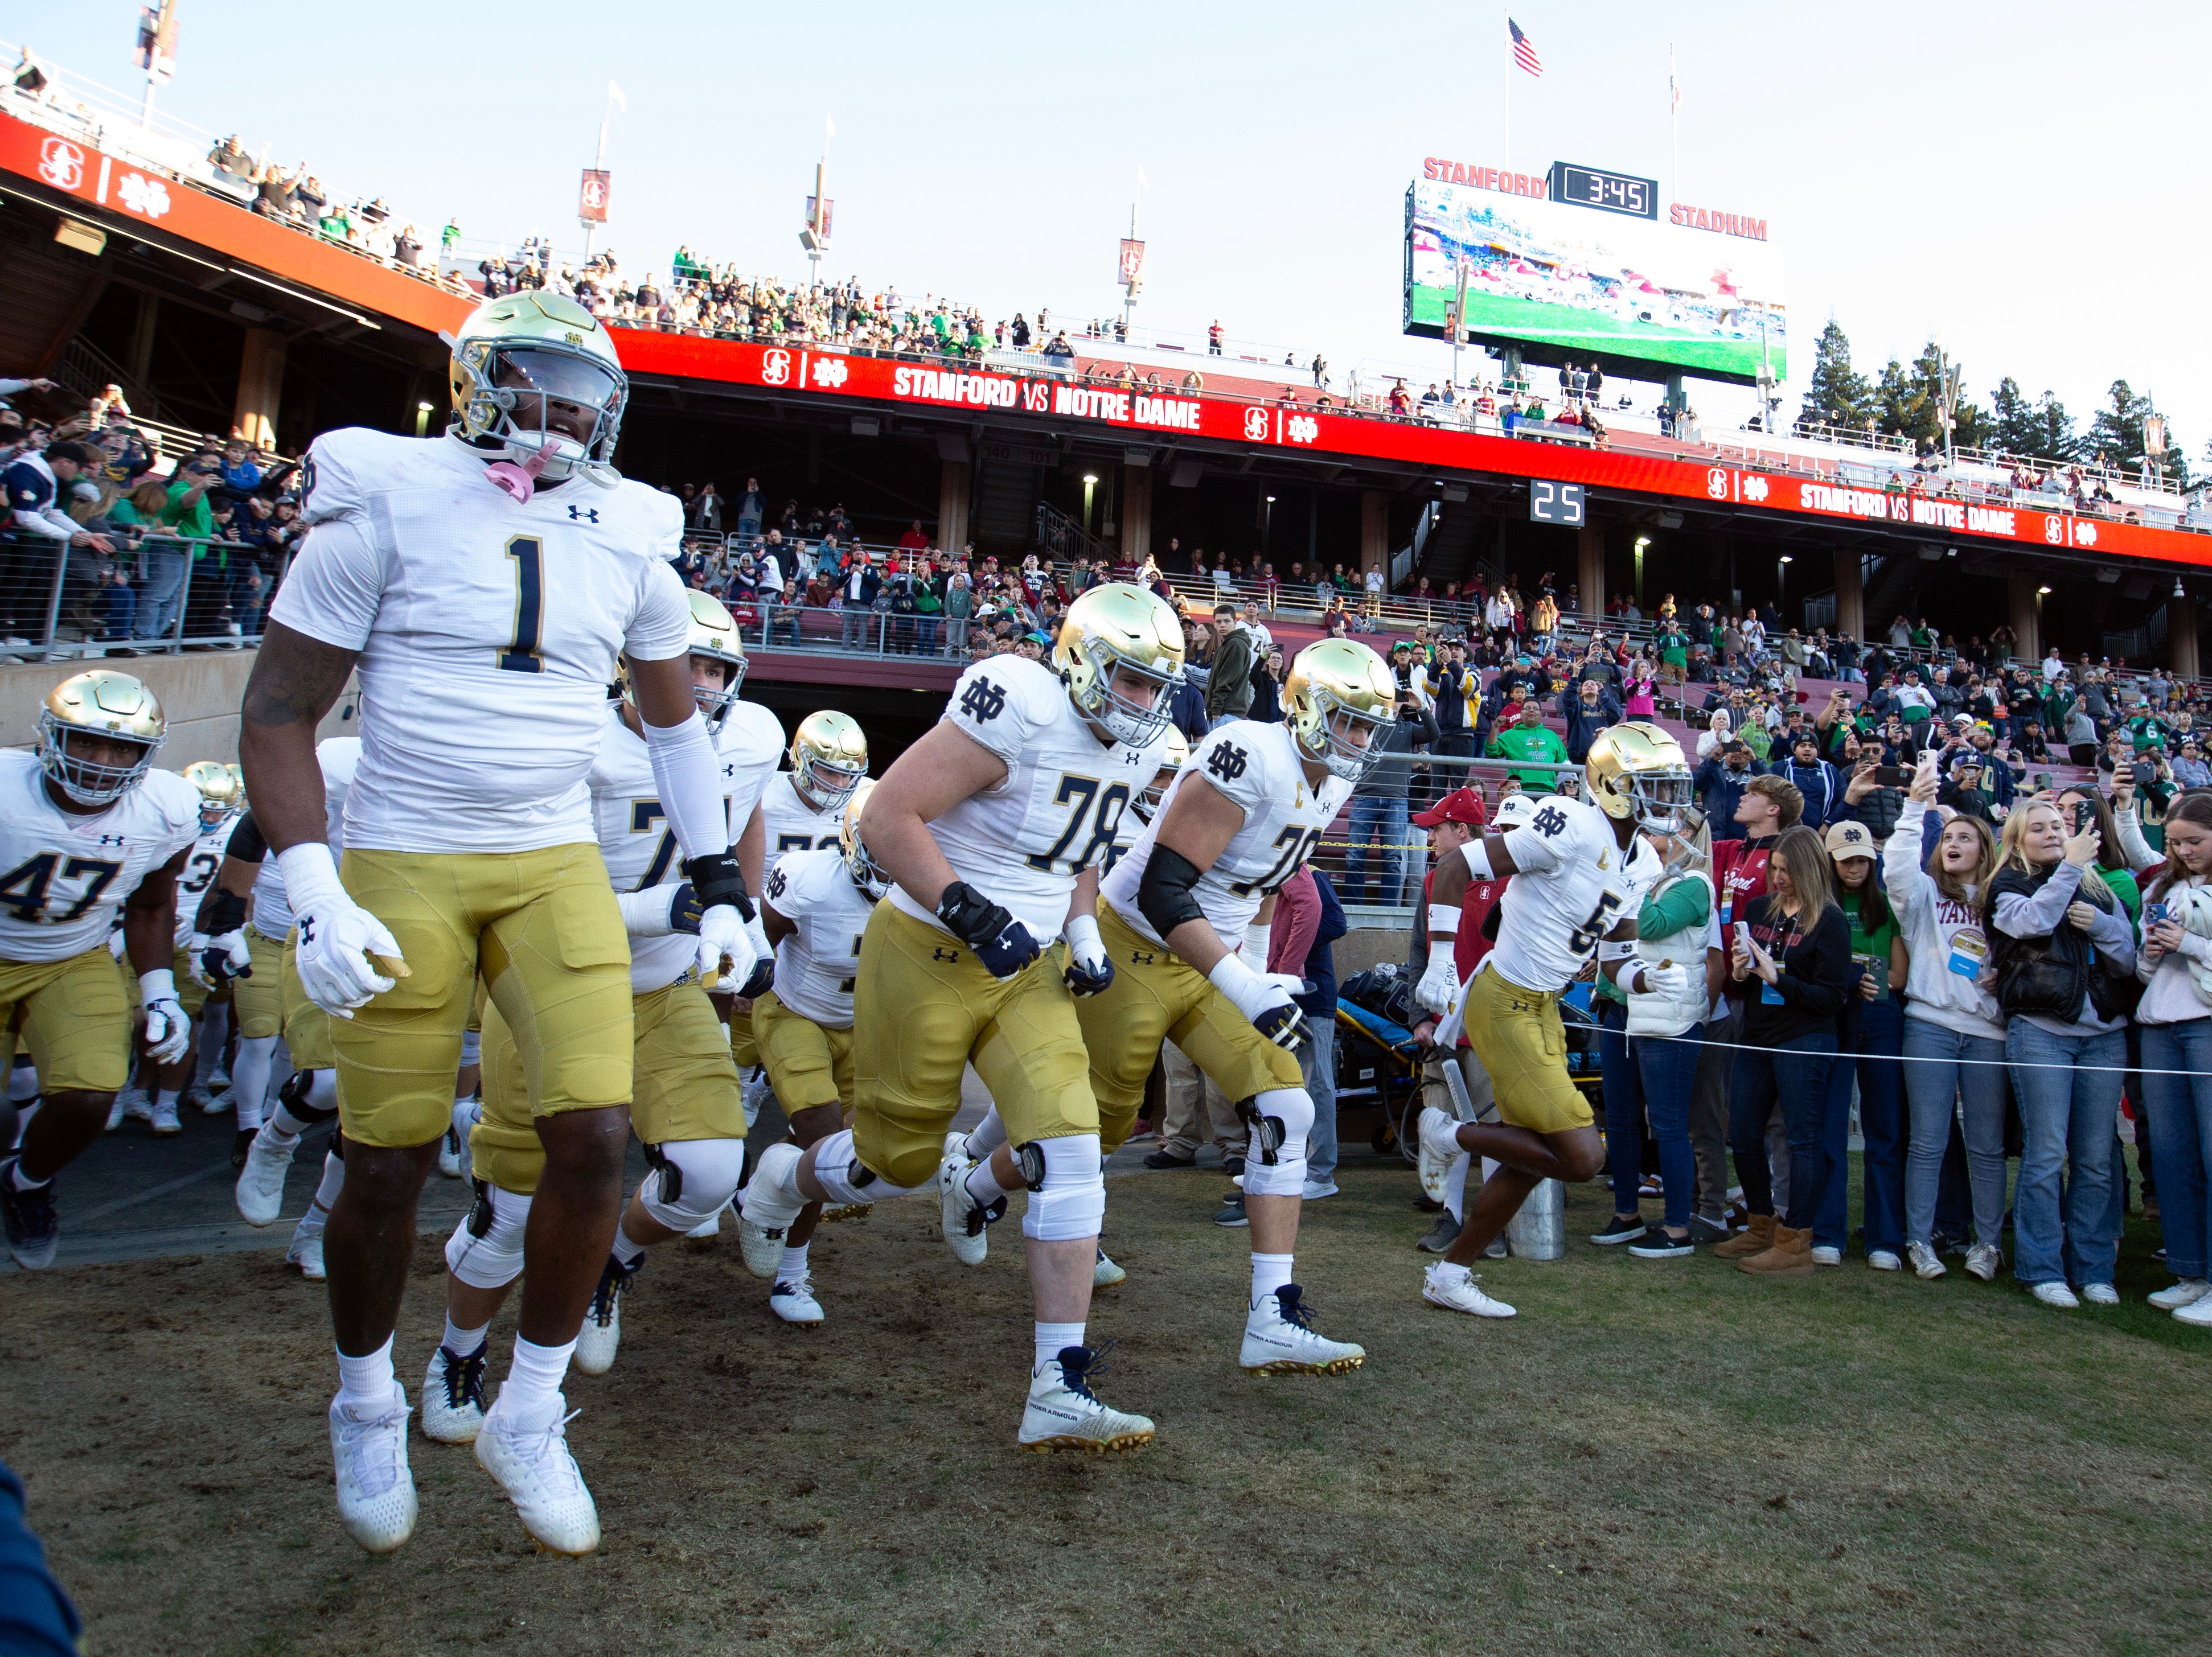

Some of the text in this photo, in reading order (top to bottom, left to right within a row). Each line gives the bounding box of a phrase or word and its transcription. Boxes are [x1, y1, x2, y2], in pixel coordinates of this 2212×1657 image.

[1424, 157, 1546, 199] STANFORD
[1590, 175, 1643, 211] 3:45
[1671, 203, 1767, 241] STADIUM
[894, 367, 1200, 430] STANFORD VS NOTRE DAME
[985, 446, 1051, 464] 140 101
[1534, 482, 1581, 521] 25
[1800, 483, 2015, 536] STANFORD VS NOTRE DAME
[496, 533, 544, 673] 1
[1670, 637, 1679, 647] 11
[2147, 725, 2158, 739] 6
[1026, 772, 1130, 876] 78
[0, 851, 124, 924] 47
[1570, 889, 1623, 956] 5
[1936, 900, 1980, 927] TAN
[1247, 1331, 1293, 1348] UNDER ARMOUR
[1028, 1402, 1078, 1422] UNDER ARMOUR
